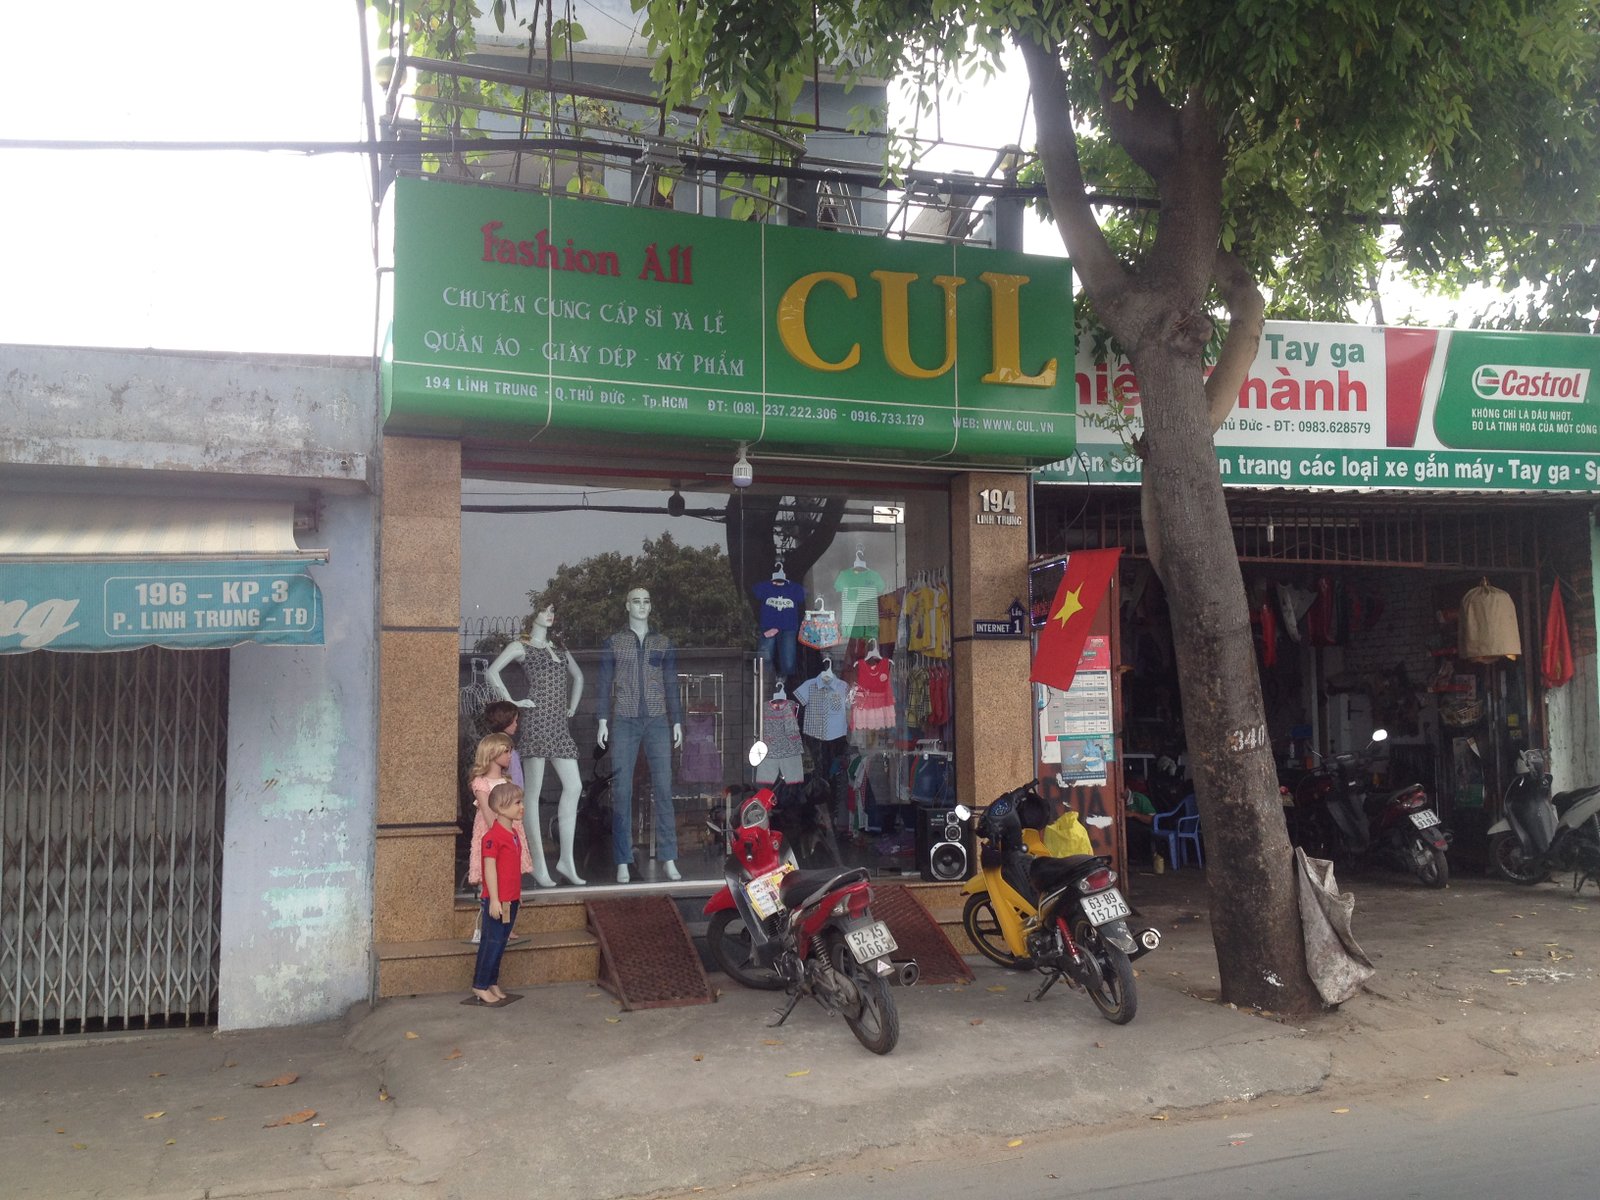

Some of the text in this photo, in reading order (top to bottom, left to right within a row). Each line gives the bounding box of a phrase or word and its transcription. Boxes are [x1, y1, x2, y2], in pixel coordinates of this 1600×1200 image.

[481, 220, 694, 286] fashion All
[534, 296, 591, 321] CUNG
[776, 271, 1058, 387] CUL
[493, 332, 520, 357] ÁO
[1265, 333, 1365, 368] Tay ga
[1204, 366, 1368, 411] hành
[1502, 368, 1582, 398] Castrol
[425, 376, 450, 390] 194
[494, 381, 538, 397] TRUNG
[952, 416, 980, 430] WEB:
[983, 418, 1054, 433] WWW.CUL.VN
[1298, 420, 1372, 435] 0983.628579
[1520, 421, 1537, 433] HOA
[1238, 454, 1291, 480] trang
[1299, 454, 1336, 477] các
[1342, 455, 1378, 481] loại
[1384, 460, 1409, 477] xe
[1414, 453, 1449, 482] gắn
[1454, 457, 1495, 483] máy
[1508, 459, 1542, 485] Tay
[1547, 464, 1570, 485] ga
[980, 488, 1016, 513] 194
[977, 514, 1022, 526] LINH TRUNG
[135, 581, 187, 606] 196
[223, 579, 289, 604] KP.3
[141, 610, 187, 631] LINH
[194, 608, 260, 629] TRUNG
[283, 607, 308, 626] TĐ
[976, 619, 1022, 634] INTERNET 1
[1088, 892, 1118, 910] 63-B9
[852, 925, 885, 946] 52-X5
[859, 937, 891, 960] 0665
